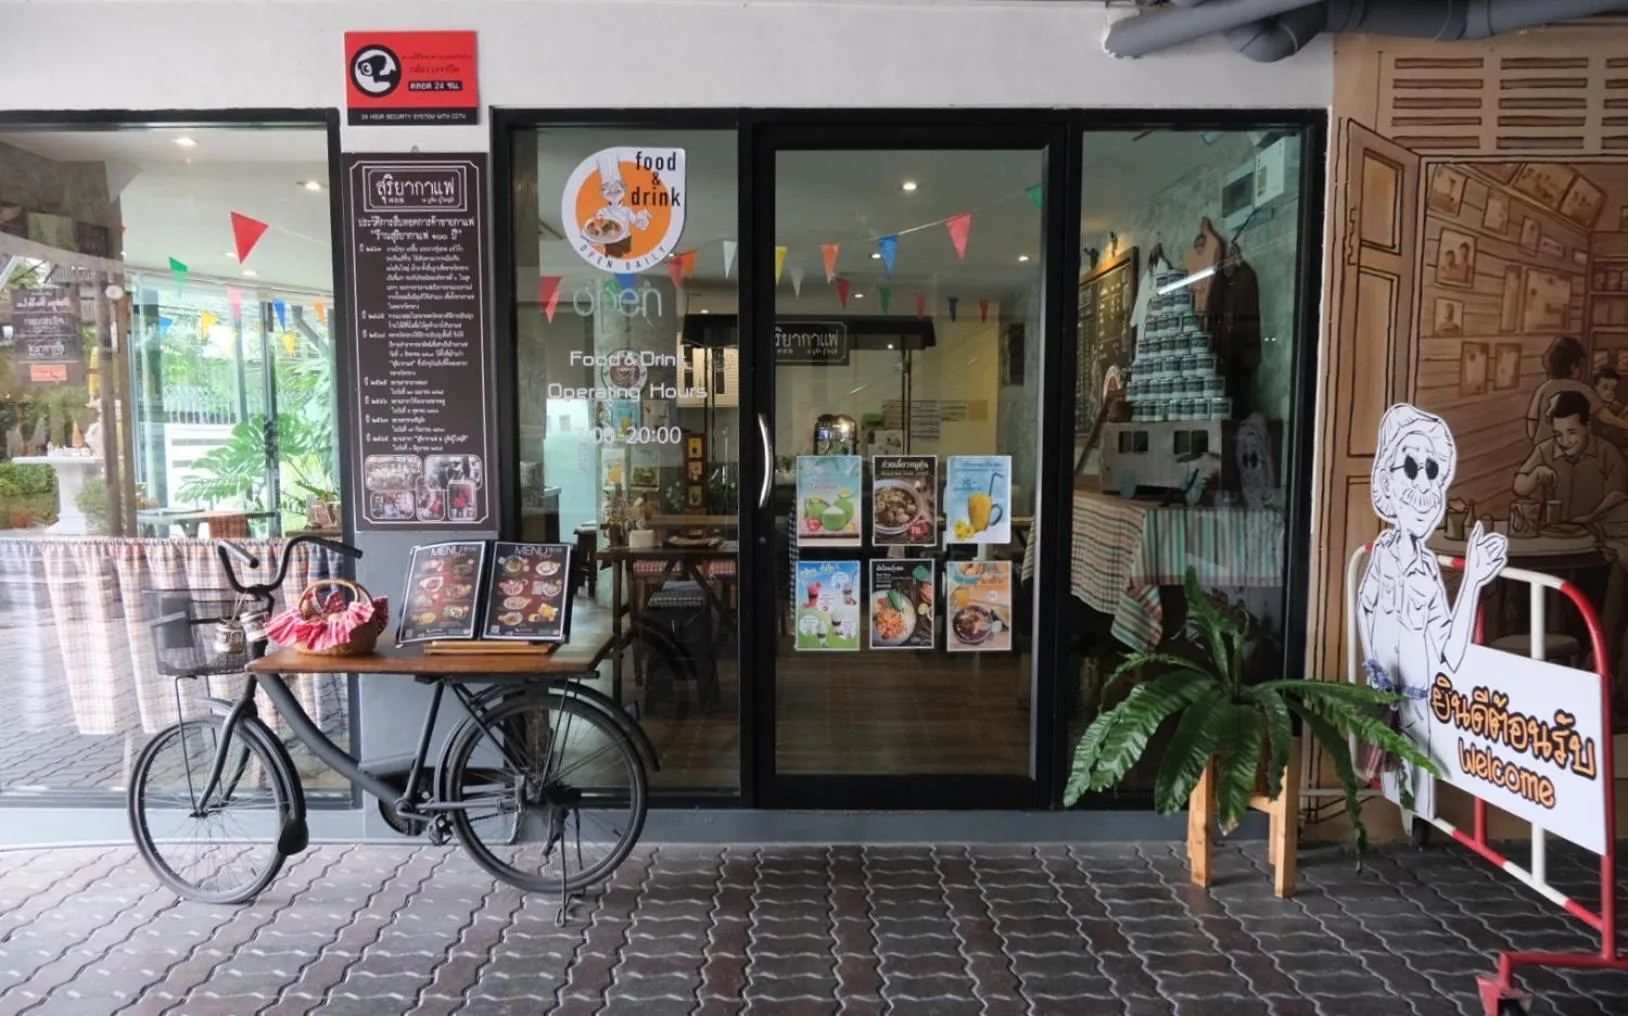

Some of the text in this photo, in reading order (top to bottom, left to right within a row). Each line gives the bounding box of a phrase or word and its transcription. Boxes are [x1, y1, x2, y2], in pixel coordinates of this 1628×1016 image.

[386, 113, 411, 121] SECURITY
[635, 151, 676, 171] food
[376, 173, 455, 204] สุริยากาแฟ
[652, 172, 661, 186] &
[631, 186, 681, 207] drink
[579, 244, 665, 270] OPEN DAILY
[573, 287, 663, 328] open
[774, 326, 839, 347] ริยากาแฟ
[570, 351, 620, 367] Food
[547, 382, 708, 402] Operating Hours
[514, 545, 548, 555] MENU
[1430, 672, 1598, 780] ยินดีต้อนรับ
